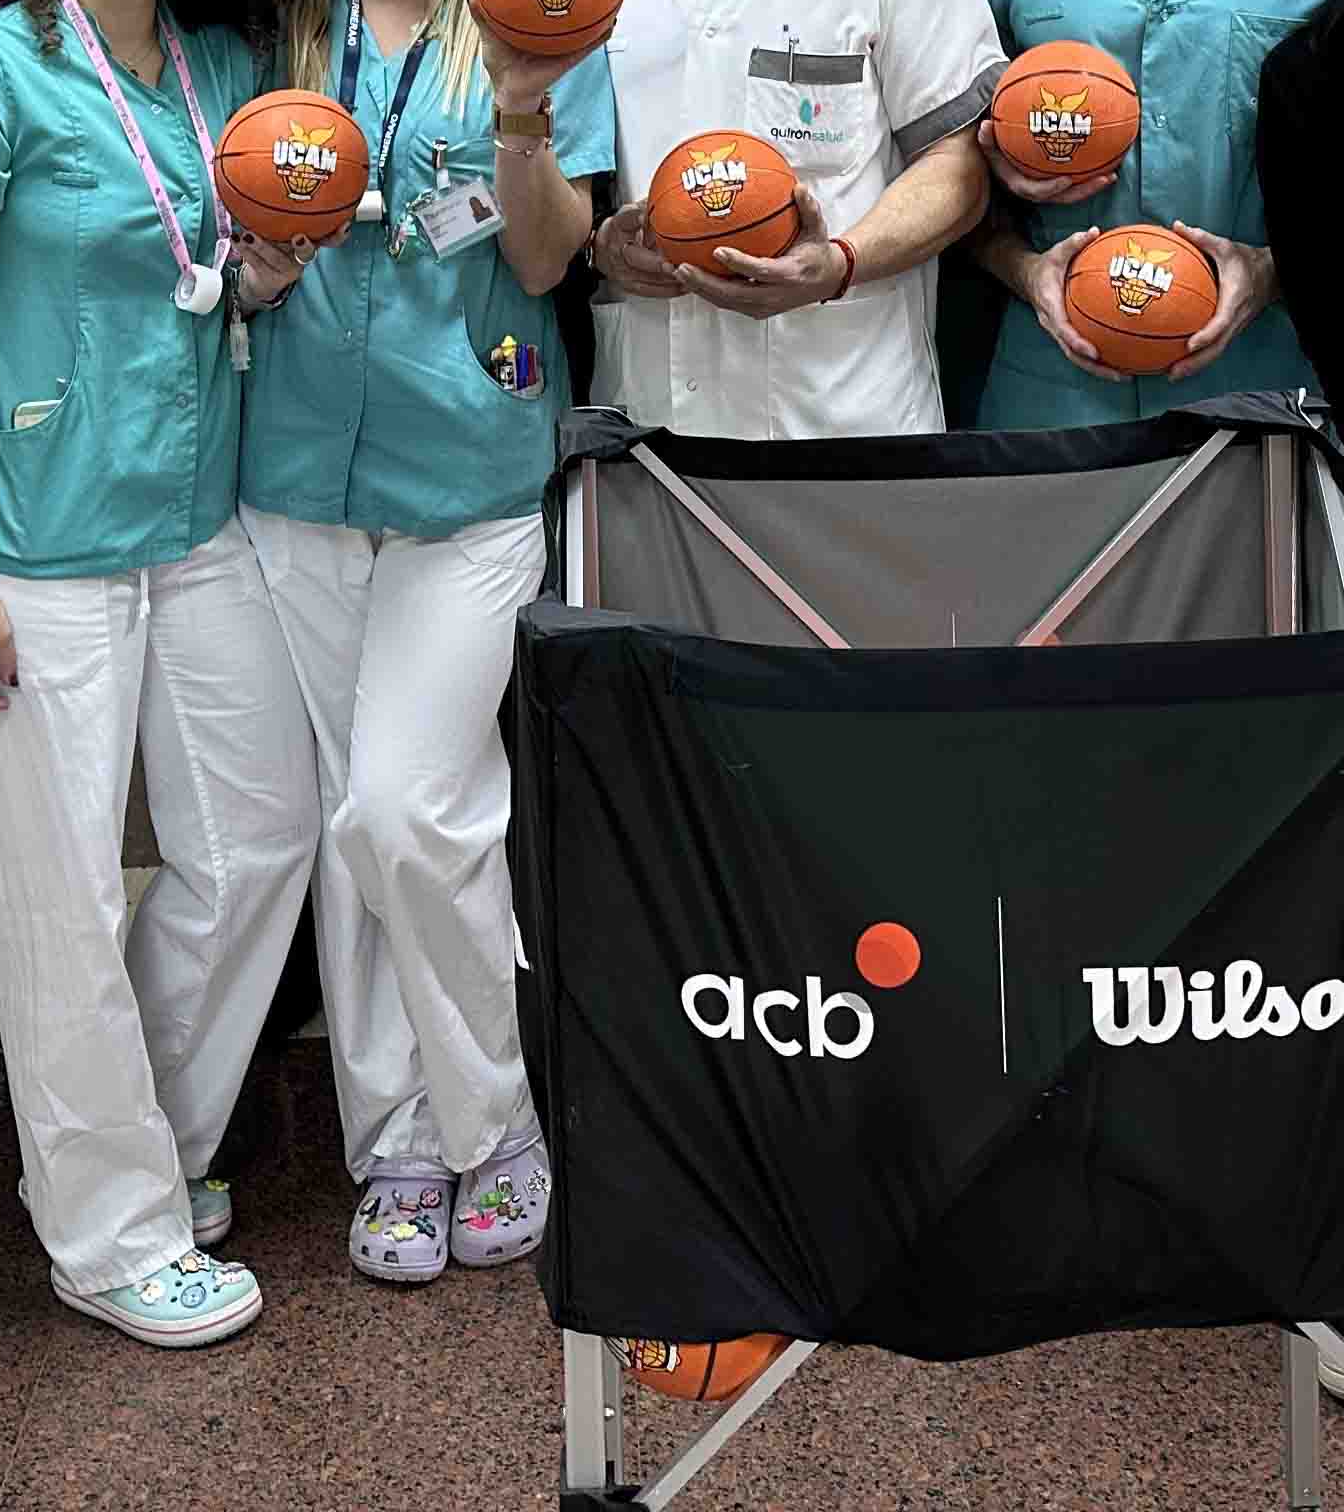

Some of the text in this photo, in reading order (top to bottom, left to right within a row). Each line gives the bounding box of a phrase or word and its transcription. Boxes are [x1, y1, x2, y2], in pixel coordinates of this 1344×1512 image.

[1028, 110, 1093, 136] UCAM
[272, 140, 338, 172] UCAM
[681, 160, 747, 190] UCAM
[1109, 254, 1174, 292] UCAM
[680, 971, 876, 1060] acb
